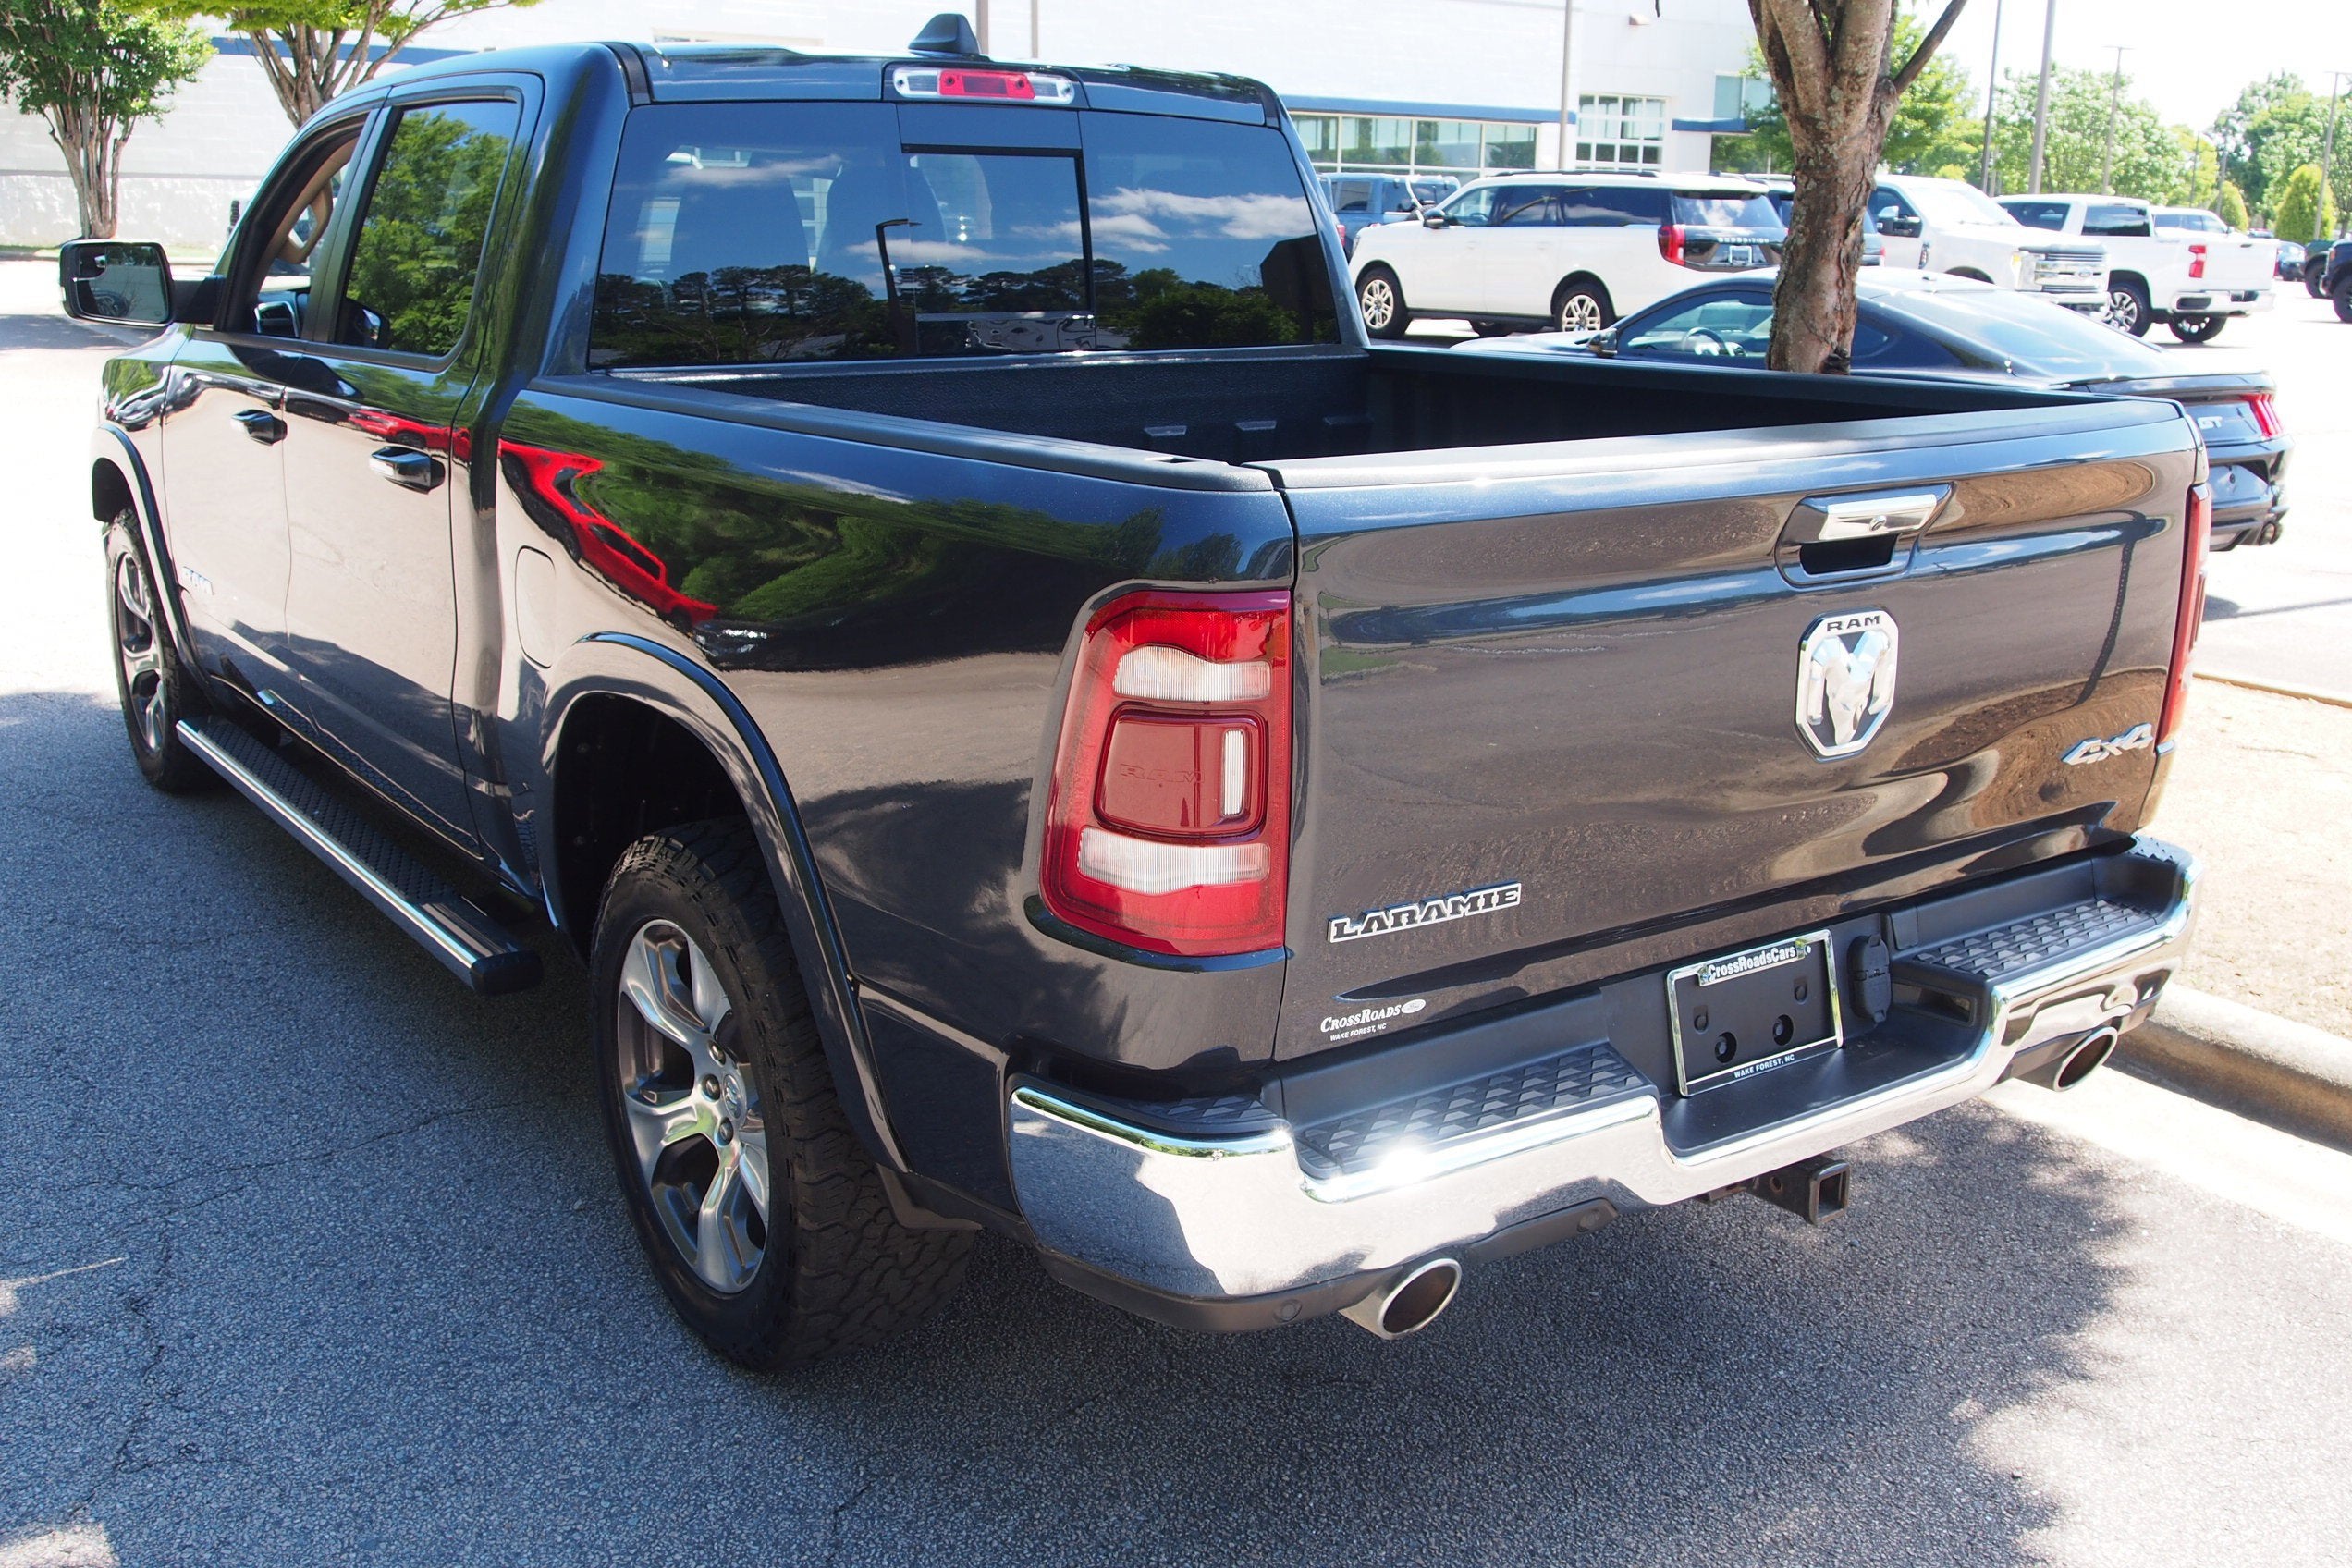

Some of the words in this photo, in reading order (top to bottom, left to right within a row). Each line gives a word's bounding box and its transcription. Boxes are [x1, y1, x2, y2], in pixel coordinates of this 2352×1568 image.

[2197, 415, 2223, 430] GT
[1826, 615, 1880, 632] RAM
[1120, 763, 1205, 784] RAM
[1329, 881, 1522, 943] LARAMIE
[1707, 945, 1796, 982] CrossRoadsCars
[1330, 1031, 1350, 1042] WAKE
[1350, 1025, 1376, 1036] FOREST,
[1733, 1066, 1755, 1079] WAKE
[1755, 1058, 1784, 1072] FOREST,
[1784, 1053, 1795, 1062] NC
